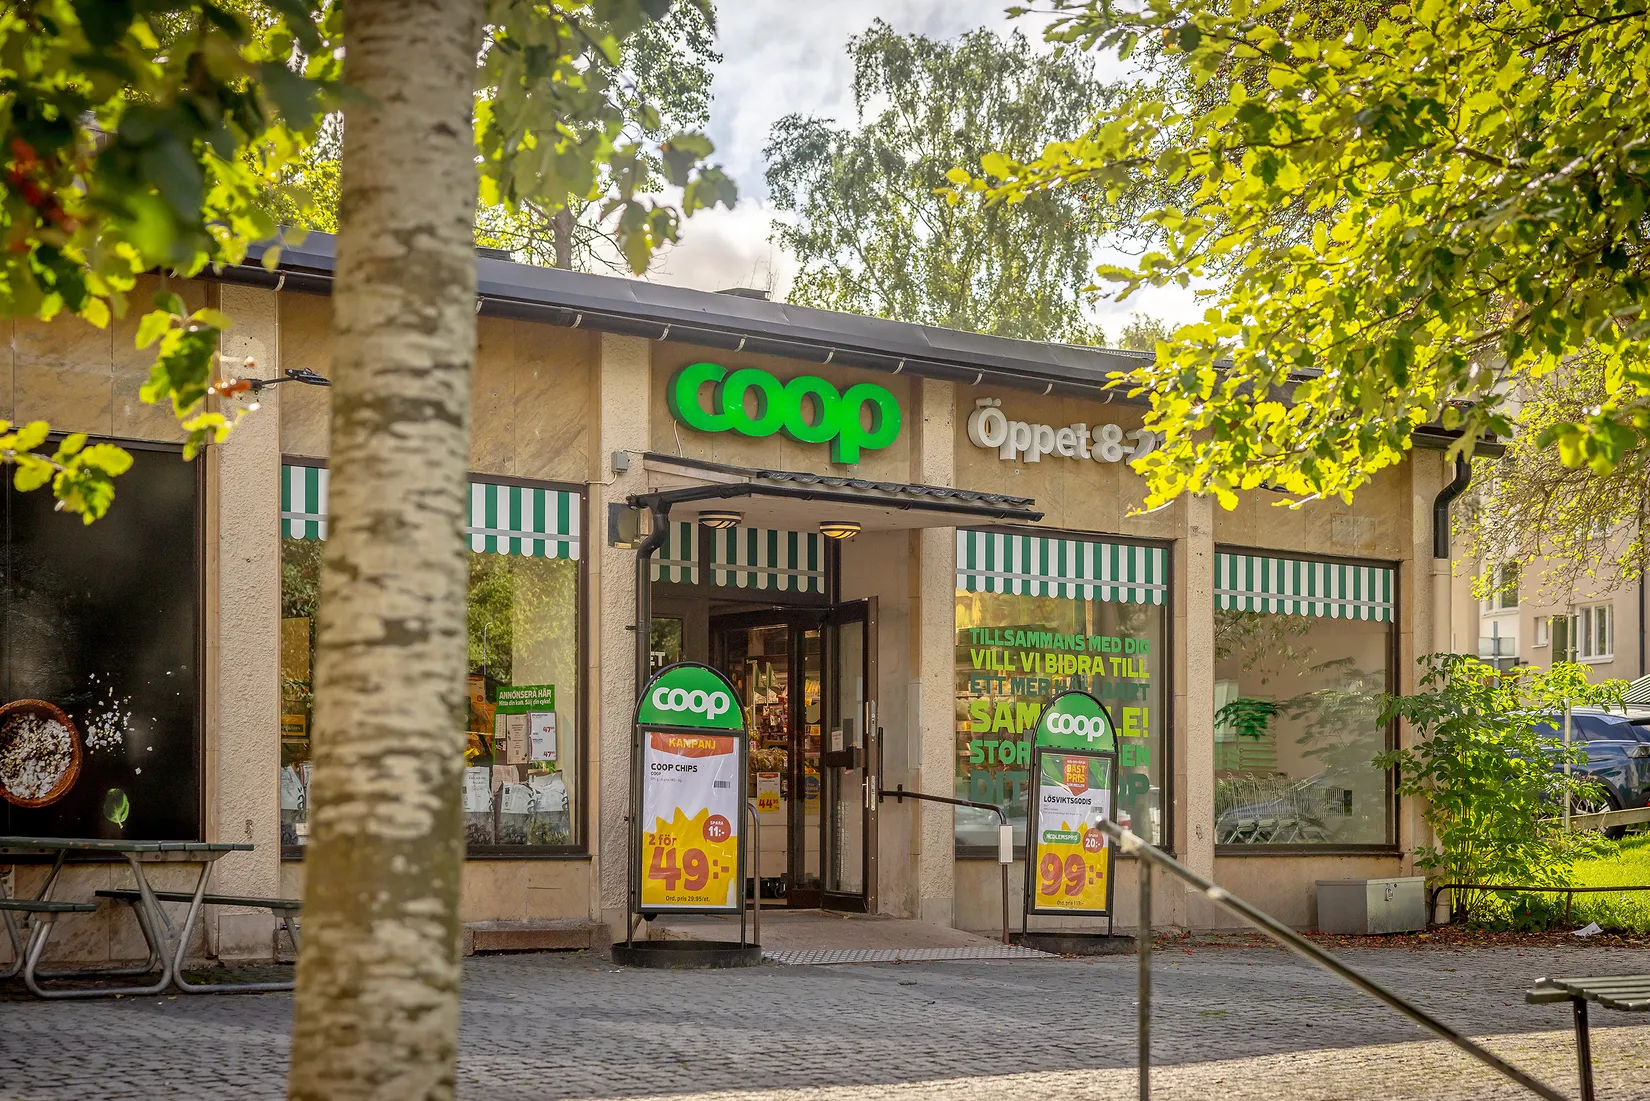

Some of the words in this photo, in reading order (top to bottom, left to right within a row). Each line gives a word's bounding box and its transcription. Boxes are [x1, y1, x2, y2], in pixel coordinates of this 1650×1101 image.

[667, 362, 901, 464] coop
[968, 398, 1092, 464] Öppet
[1092, 423, 1165, 466] 8-2
[969, 628, 1085, 651] TILLSAMMANS
[1089, 635, 1122, 653] MED
[1125, 637, 1150, 655] DIG
[970, 648, 1016, 672] VILL
[1020, 651, 1040, 673] VI
[1045, 653, 1106, 676] BIDRA
[1109, 657, 1150, 678] TILL
[499, 690, 538, 700] ANNONSERA
[538, 688, 552, 698] HÄR
[970, 674, 1007, 695] ETT
[1010, 676, 1050, 697] MER
[652, 687, 730, 720] coop
[1046, 712, 1105, 742] coop
[668, 738, 716, 750] KAMPANJ
[651, 763, 674, 772] COOP
[675, 764, 698, 773] CHIPS
[1066, 773, 1086, 783] PRIS
[970, 771, 1028, 806] DIT
[1044, 795, 1092, 805] LÖSVIKTSGODIS
[648, 834, 656, 846] 2
[658, 833, 677, 846] för
[708, 826, 725, 837] 11:-
[1045, 833, 1078, 841] MEDLEMSPRIS
[1085, 838, 1101, 848] 20:-
[648, 846, 729, 891] 49:-
[1040, 852, 1103, 896] 99:-
